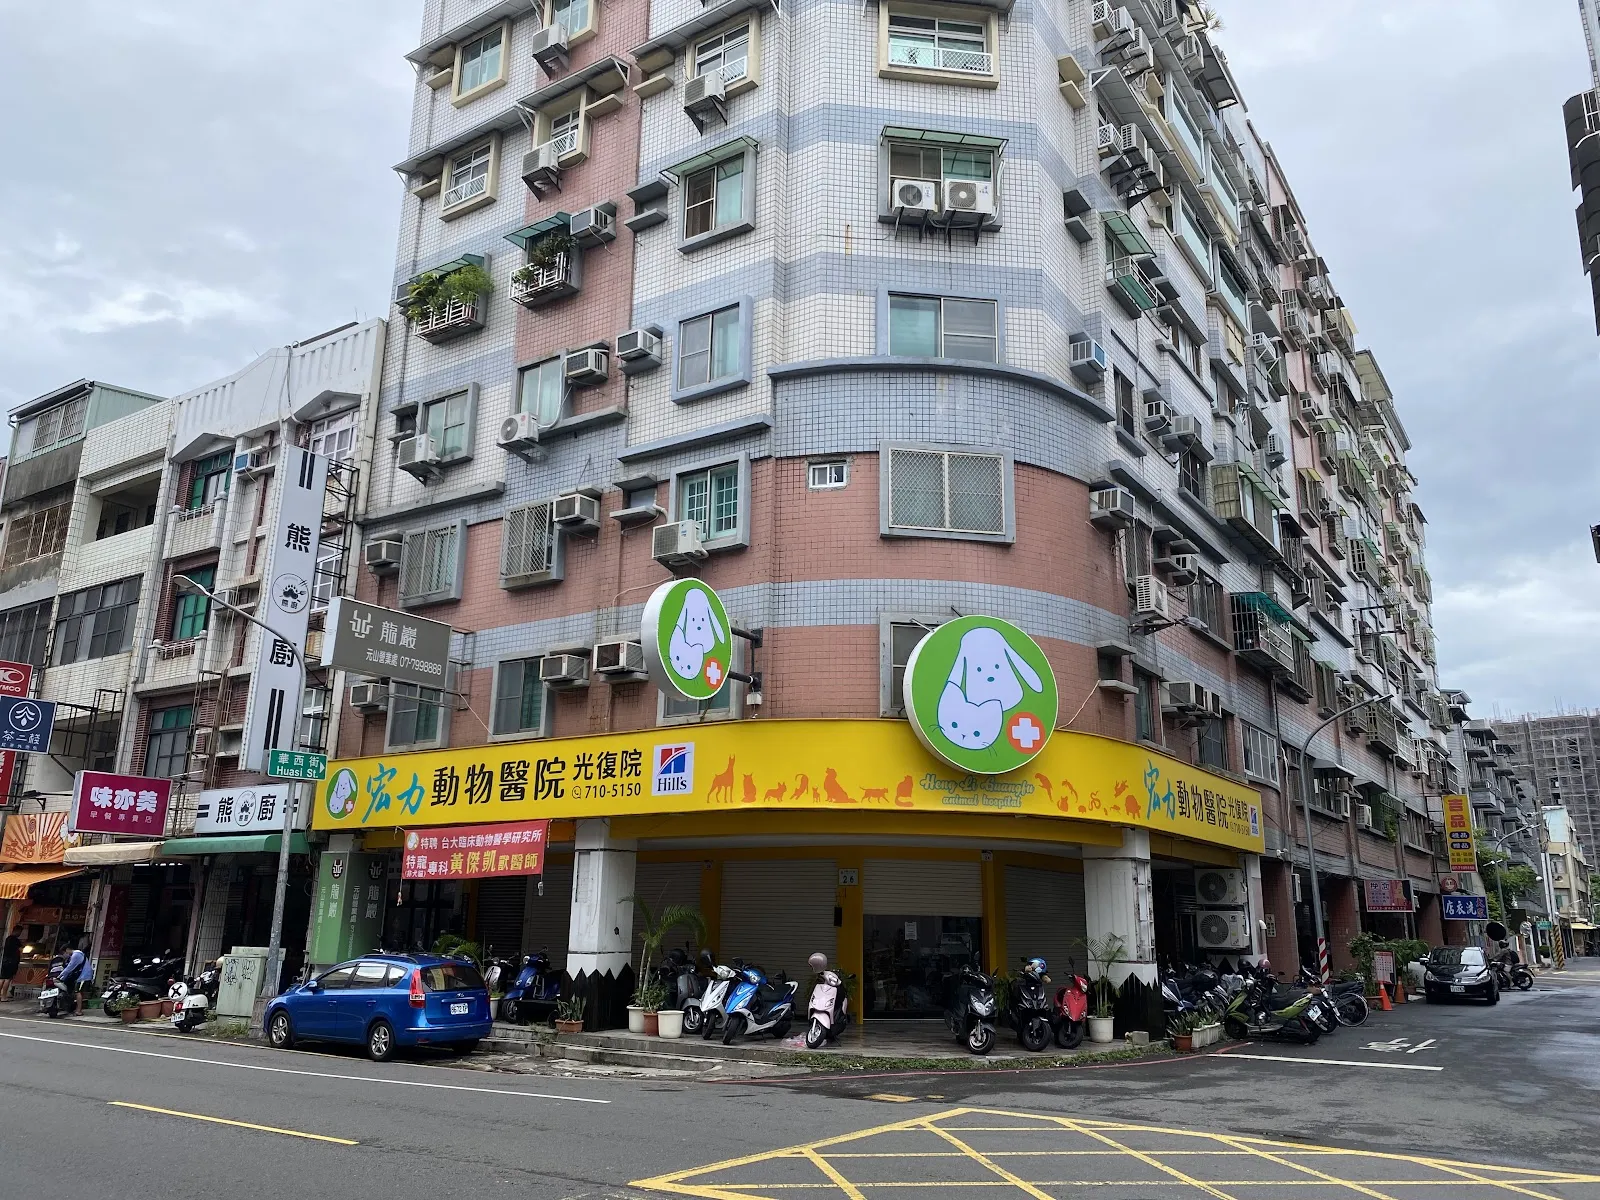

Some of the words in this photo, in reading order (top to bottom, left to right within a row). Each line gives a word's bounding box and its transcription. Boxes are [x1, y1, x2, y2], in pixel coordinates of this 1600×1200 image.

[284, 523, 311, 554] 熊
[379, 620, 417, 650] 龍巖
[365, 648, 399, 667] 元山營業處
[399, 656, 442, 676] 07-7998888
[278, 753, 320, 768] 華西街
[573, 748, 642, 781] 光復院
[276, 766, 303, 777] Huasi
[306, 768, 319, 779] St.
[959, 774, 978, 792] Li
[585, 783, 641, 799] 710-5150
[657, 776, 687, 792] Hill's
[90, 786, 158, 814] 味亦美
[216, 796, 234, 824] 熊
[257, 794, 277, 821] 廚
[942, 794, 980, 806] animal
[981, 794, 1022, 809] hospital
[420, 836, 438, 850] 特聘
[441, 829, 543, 849] 台大臨床動物醫學研究所
[405, 854, 428, 870] 特寵
[427, 860, 449, 876] 專科
[843, 875, 855, 884] 26
